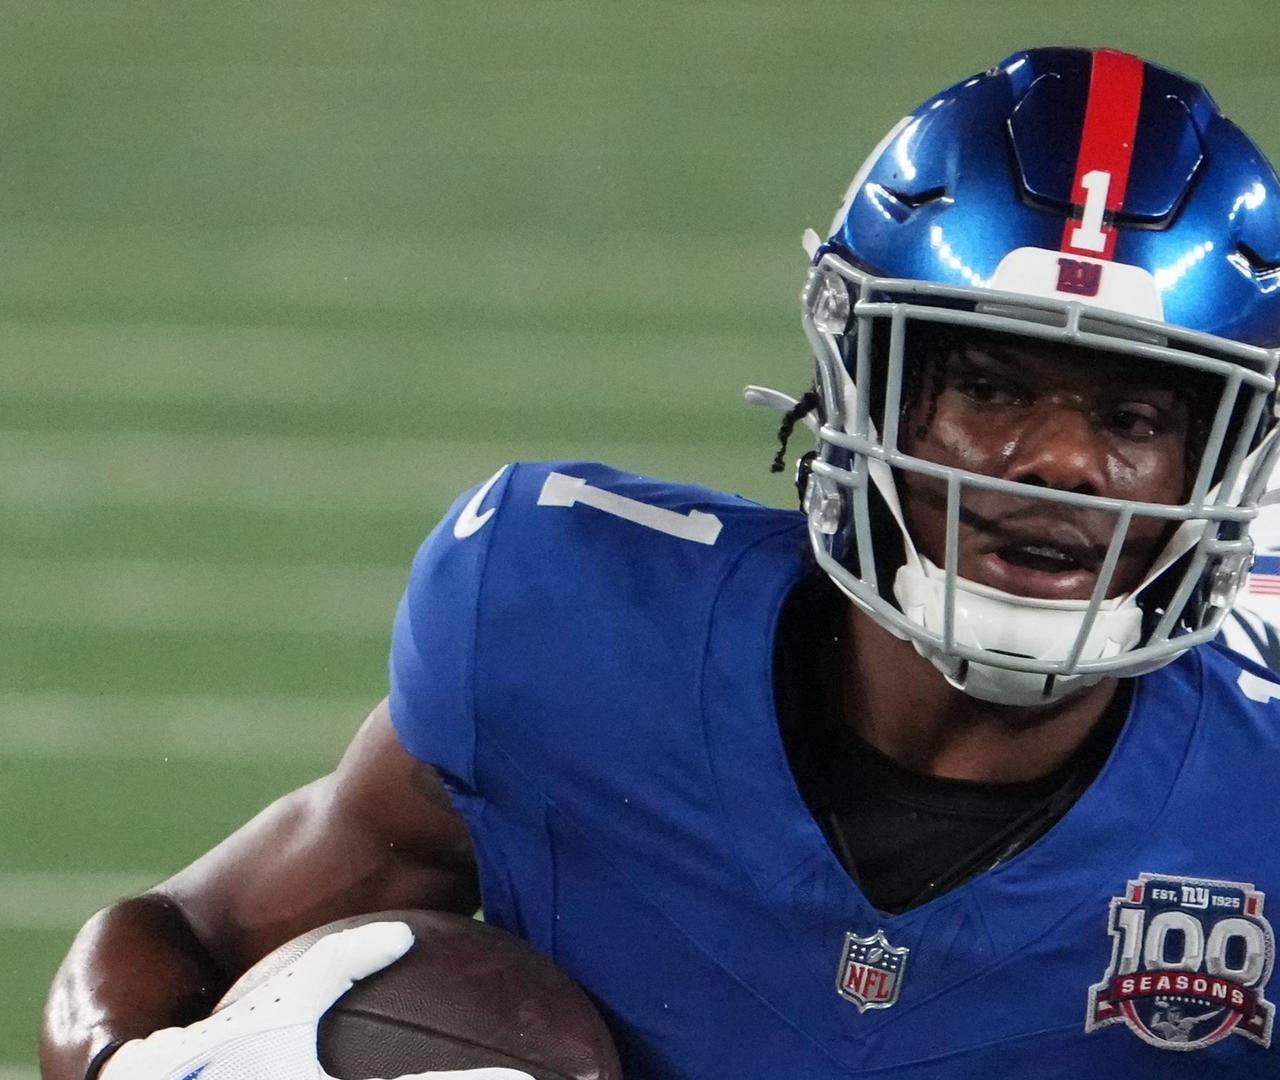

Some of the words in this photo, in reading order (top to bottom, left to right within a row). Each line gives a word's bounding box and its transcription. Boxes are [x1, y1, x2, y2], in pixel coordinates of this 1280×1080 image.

[1070, 169, 1111, 253] 1
[537, 471, 724, 546] 1
[1151, 888, 1178, 902] EST.
[1212, 895, 1241, 908] 1925
[1118, 907, 1266, 986] 100
[844, 962, 890, 999] NFL
[1121, 975, 1245, 1006] SEASONS
